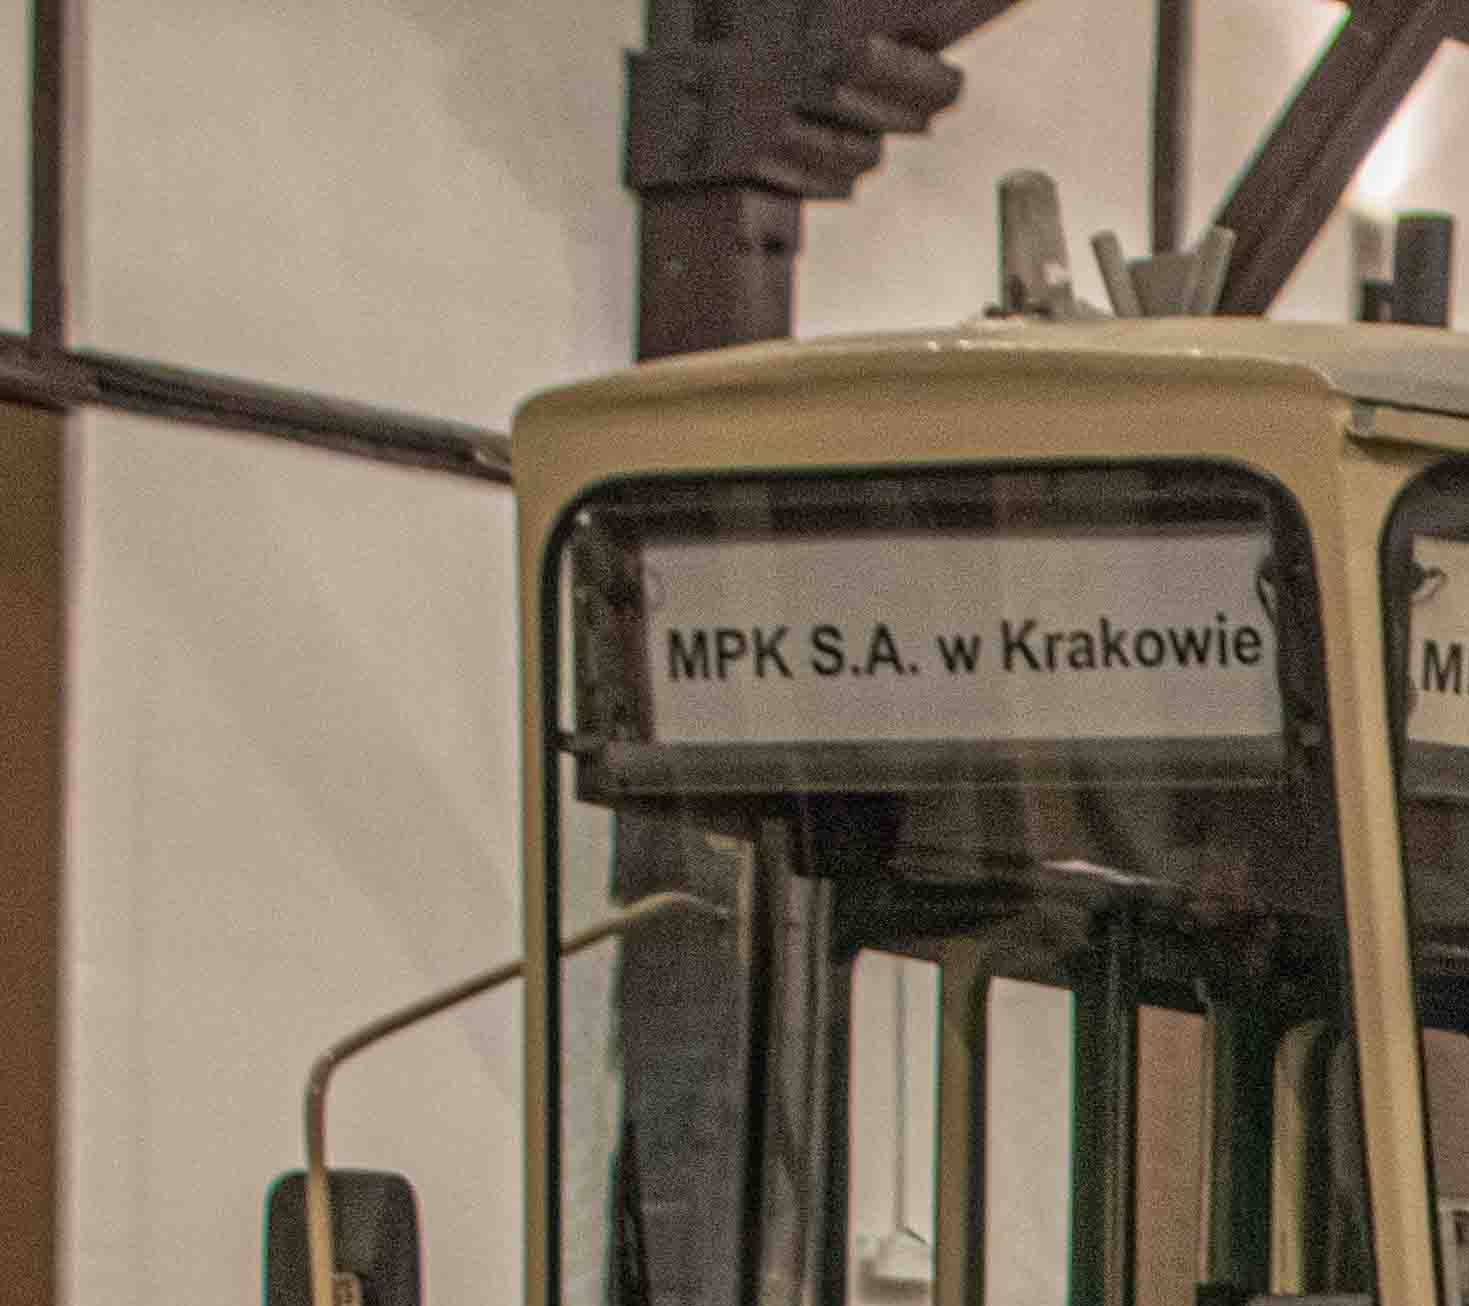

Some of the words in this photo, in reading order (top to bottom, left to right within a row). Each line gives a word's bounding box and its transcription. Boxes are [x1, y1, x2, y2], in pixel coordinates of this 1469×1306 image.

[666, 625, 793, 682] MPK
[809, 622, 919, 677] S.A.
[935, 634, 983, 675] w
[999, 611, 1264, 673] Krakowie
